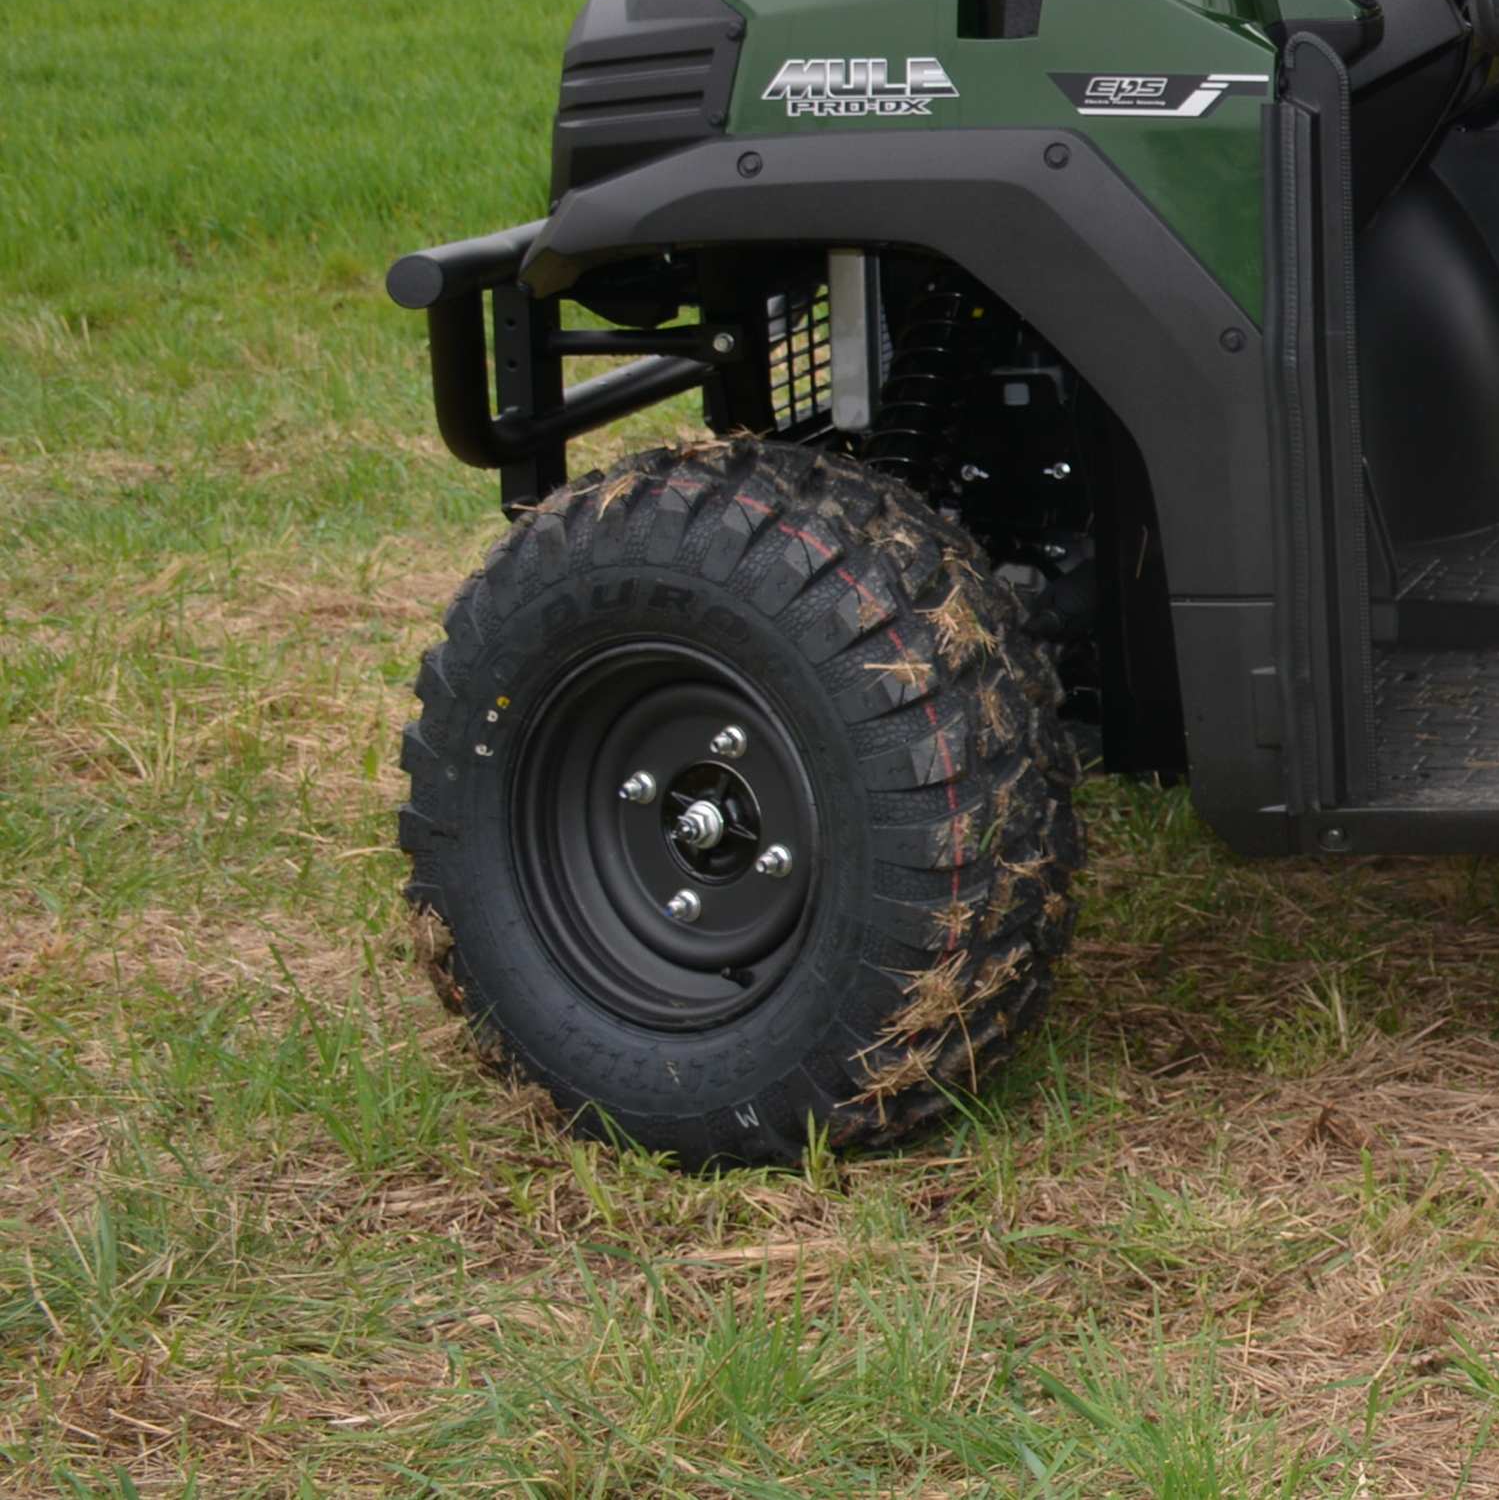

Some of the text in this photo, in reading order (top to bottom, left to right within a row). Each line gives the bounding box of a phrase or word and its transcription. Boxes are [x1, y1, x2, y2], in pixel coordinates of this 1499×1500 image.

[762, 57, 960, 100] MULE
[787, 99, 933, 117] PRO-DX
[540, 576, 753, 644] DURO
